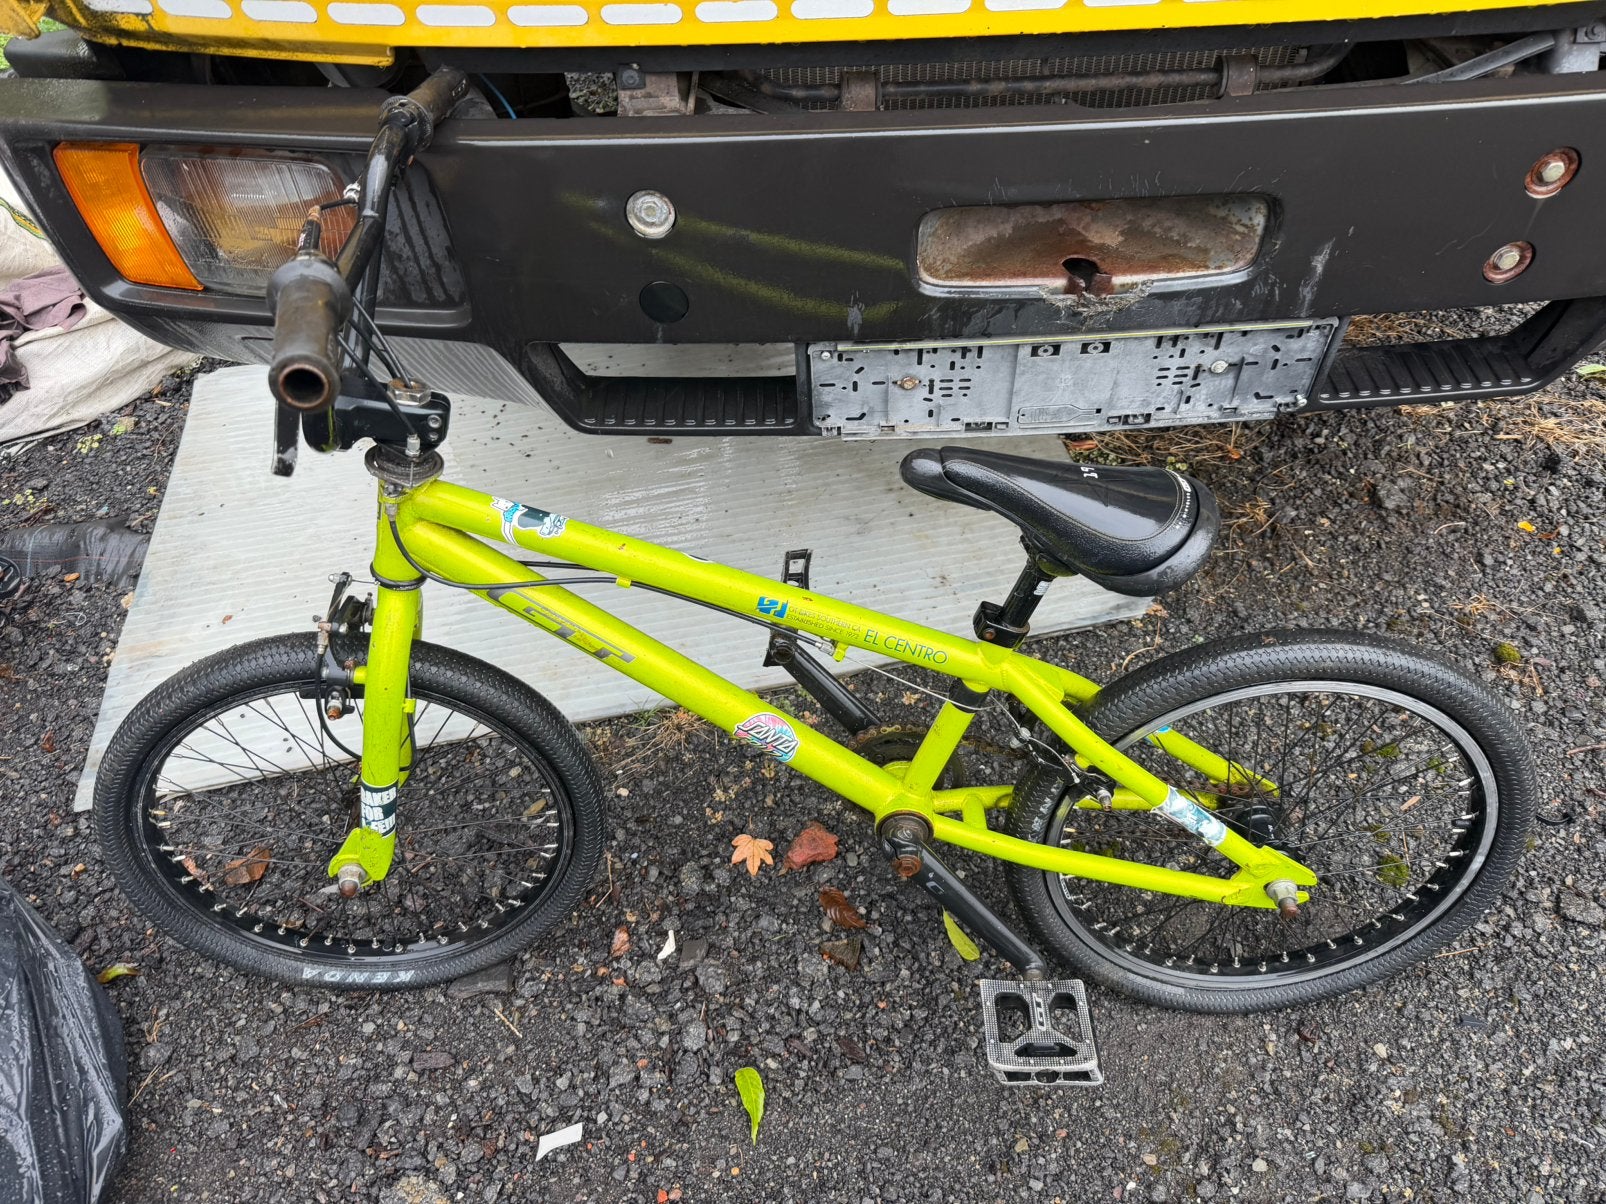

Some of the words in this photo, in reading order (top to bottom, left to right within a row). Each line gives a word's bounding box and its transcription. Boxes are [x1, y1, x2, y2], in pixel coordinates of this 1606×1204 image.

[863, 629, 879, 646] EL
[884, 635, 948, 664] CENTRO
[737, 721, 798, 754] SANTA
[302, 967, 416, 984] KENDA
